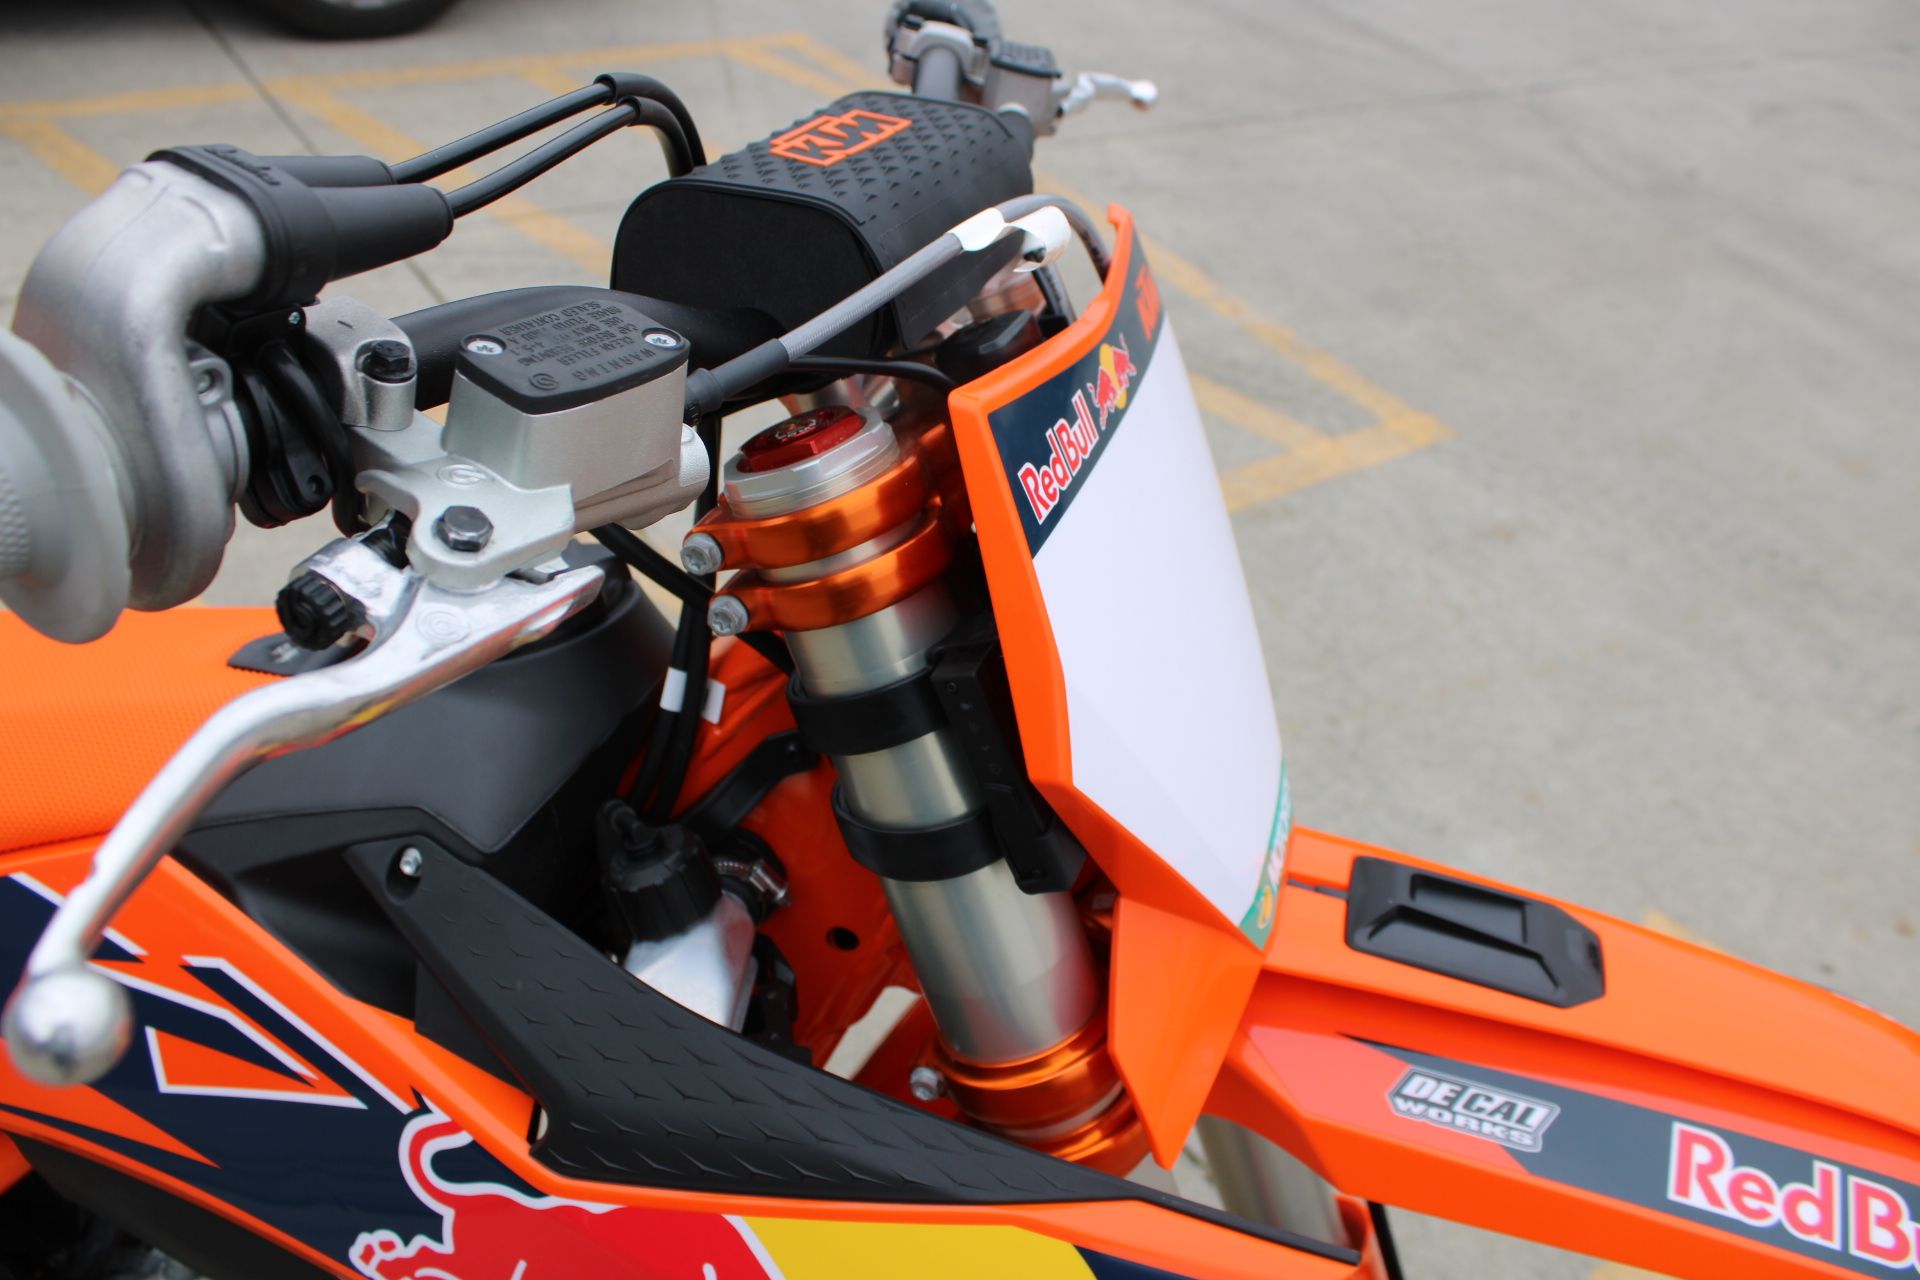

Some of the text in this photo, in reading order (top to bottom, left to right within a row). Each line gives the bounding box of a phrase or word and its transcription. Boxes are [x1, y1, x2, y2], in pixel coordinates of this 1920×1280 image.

[769, 109, 912, 167] KTM
[498, 301, 601, 336] SEALED CONTAINER
[551, 316, 588, 331] FLUID
[556, 336, 634, 366] CLEAN FILLER
[572, 348, 657, 381] WARNING
[1393, 1096, 1535, 1146] WORKS
[1847, 1173, 1920, 1275] B
